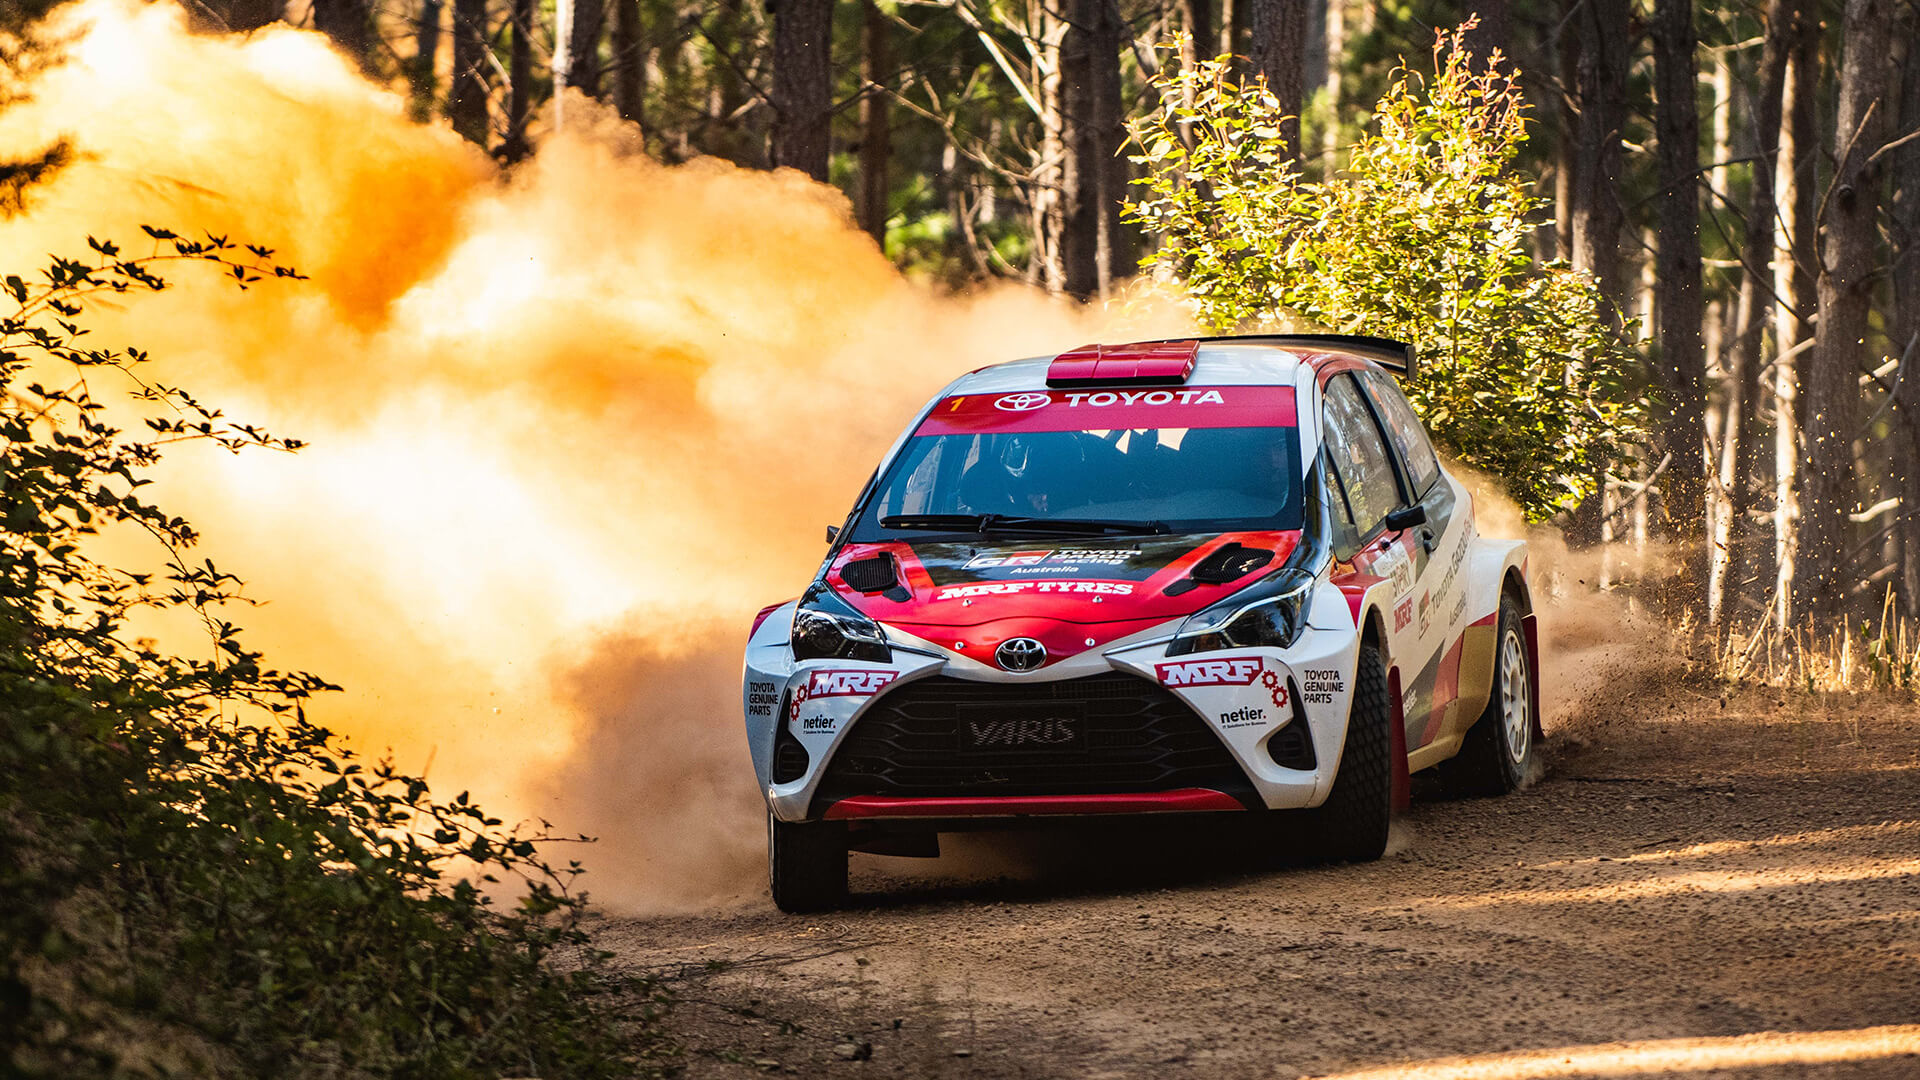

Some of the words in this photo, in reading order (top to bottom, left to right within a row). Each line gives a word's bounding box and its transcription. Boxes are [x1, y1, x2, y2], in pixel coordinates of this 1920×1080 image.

[951, 396, 966, 411] 1
[1064, 390, 1225, 408] TOYOTA
[966, 555, 1044, 569] GR
[1010, 566, 1080, 575] Australia
[937, 582, 1034, 600] MRF
[1037, 581, 1134, 595] TYRES
[1393, 596, 1412, 634] MRF
[1161, 660, 1260, 686] MRF
[1304, 670, 1341, 681] TOYOTA
[749, 682, 776, 693] TOYOTA
[810, 672, 894, 696] MRF
[1304, 682, 1344, 692] GENUINE
[749, 693, 778, 705] GENUINE
[1304, 693, 1333, 704] PARTS
[748, 705, 771, 716] PARTS
[1220, 706, 1267, 724] netier.
[803, 714, 837, 729] netier.
[969, 718, 1077, 745] YARIS
